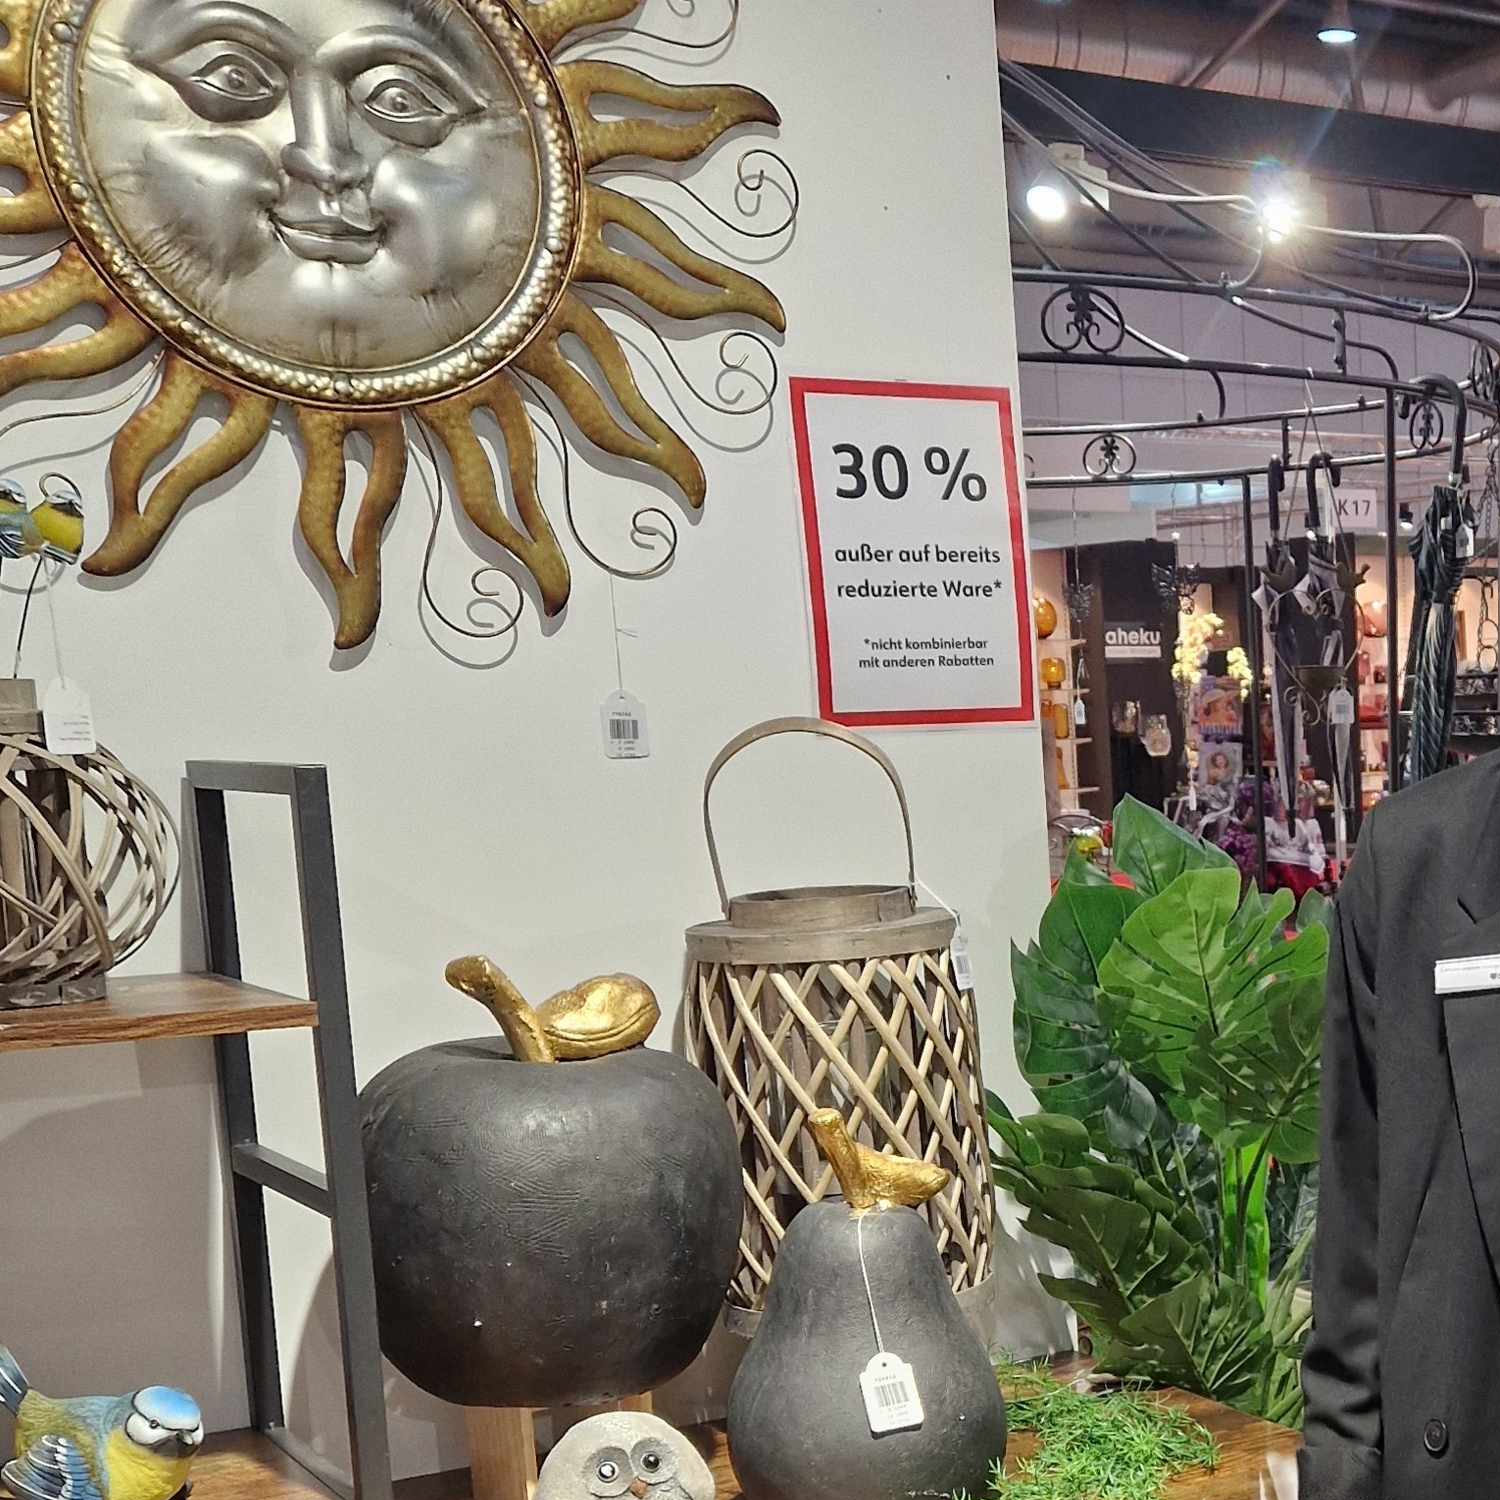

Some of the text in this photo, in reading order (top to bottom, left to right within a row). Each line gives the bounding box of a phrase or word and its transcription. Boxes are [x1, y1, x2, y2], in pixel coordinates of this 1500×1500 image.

[832, 443, 987, 502] 30 %
[1338, 498, 1371, 516] K17
[834, 543, 1001, 563] außer auf bereits
[836, 578, 938, 598] reduzierte
[905, 636, 988, 650] kombinierbar
[859, 654, 994, 668] mit anderen Rabatten
